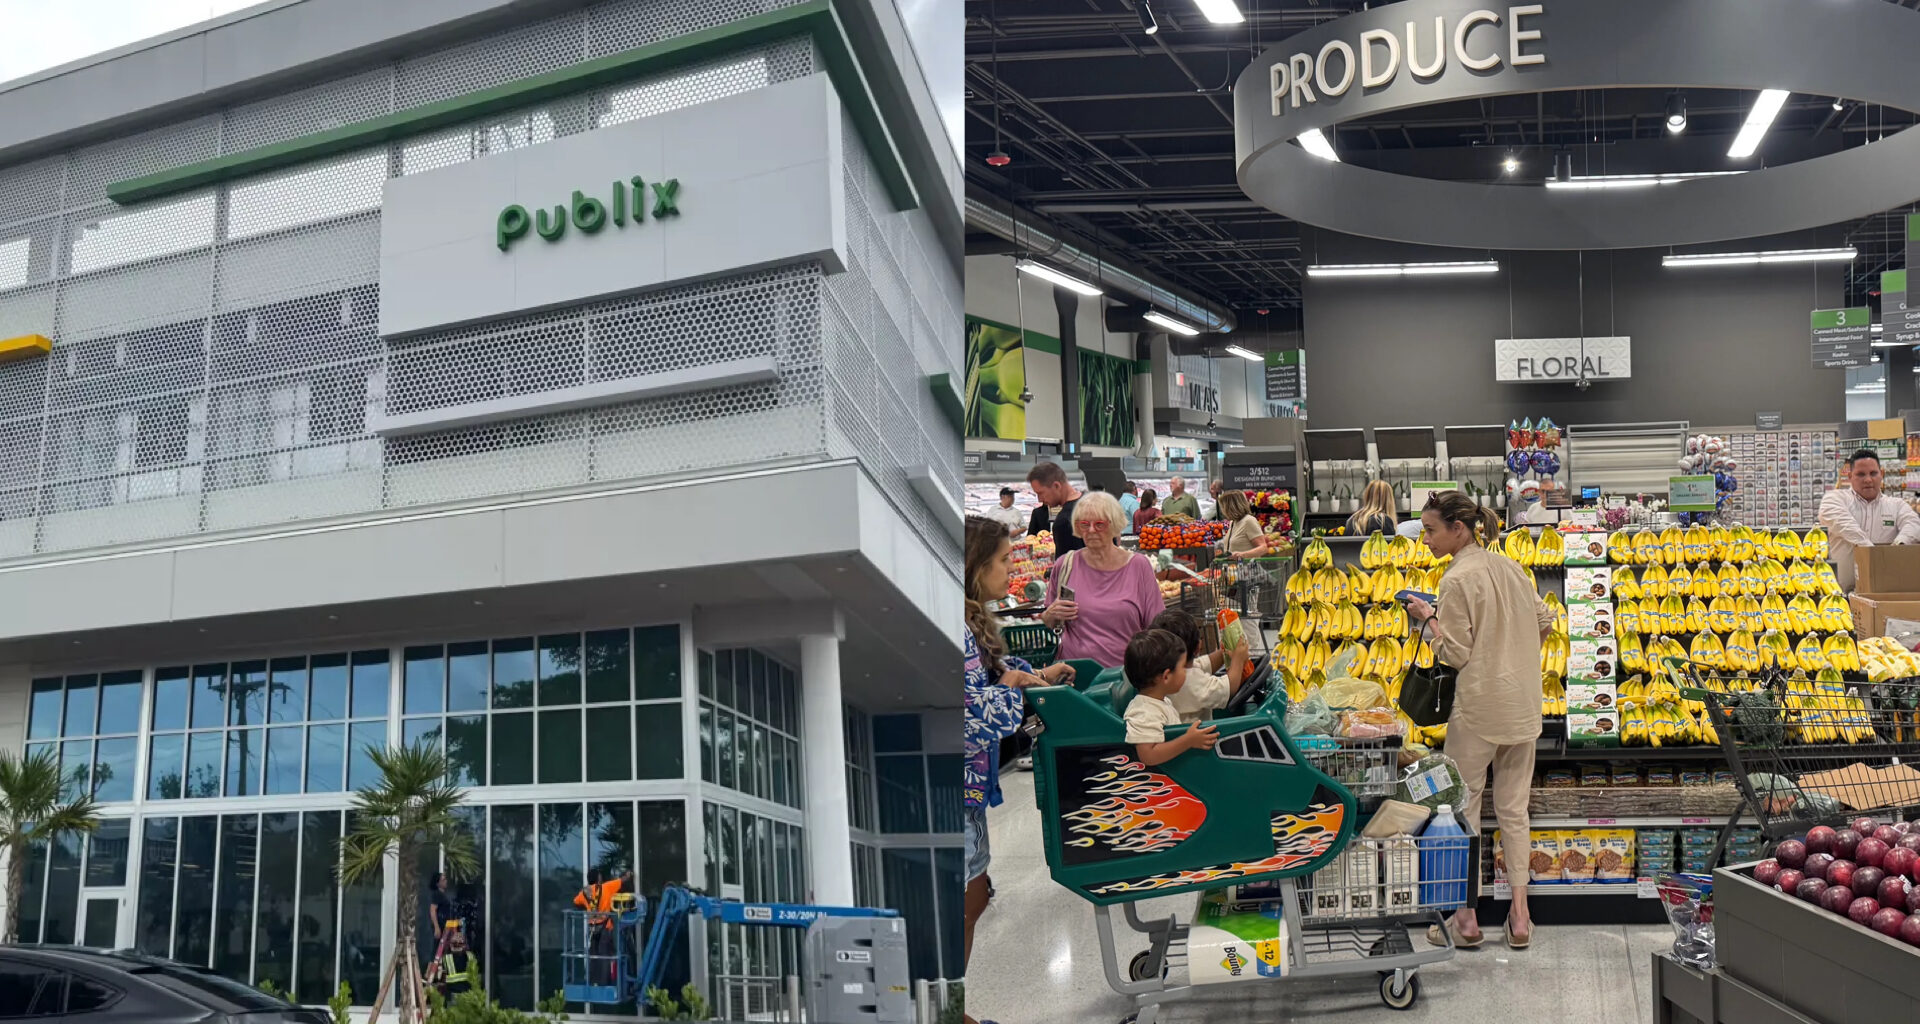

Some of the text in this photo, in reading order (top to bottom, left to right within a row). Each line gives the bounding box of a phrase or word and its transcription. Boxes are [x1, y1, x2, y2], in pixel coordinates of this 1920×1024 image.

[1270, 4, 1546, 117] PRODUCE
[497, 174, 681, 252] Publix
[1836, 311, 1846, 325] 3
[1896, 333, 1914, 341] Syrup
[1278, 352, 1284, 364] 4
[1517, 356, 1610, 378] FLORAL
[1249, 467, 1270, 476] 3/$12
[1224, 946, 1242, 976] Bounty
